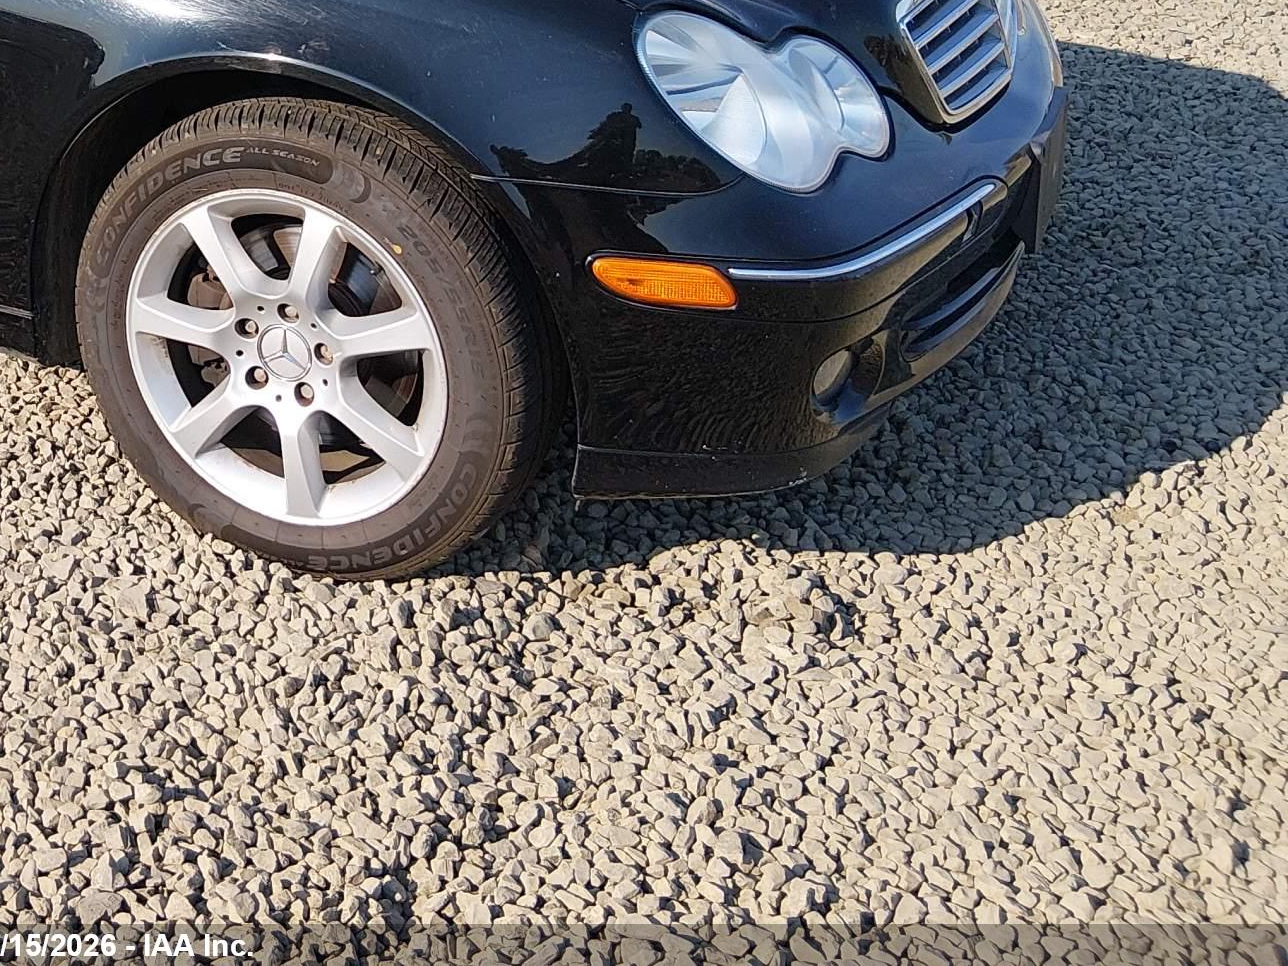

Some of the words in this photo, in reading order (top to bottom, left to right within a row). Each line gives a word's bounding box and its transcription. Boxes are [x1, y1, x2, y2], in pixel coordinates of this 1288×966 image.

[96, 146, 246, 267] CONFIDENCE
[245, 146, 270, 155] ALL
[271, 149, 321, 167] SEASON
[306, 463, 477, 571] CONFIDENCE
